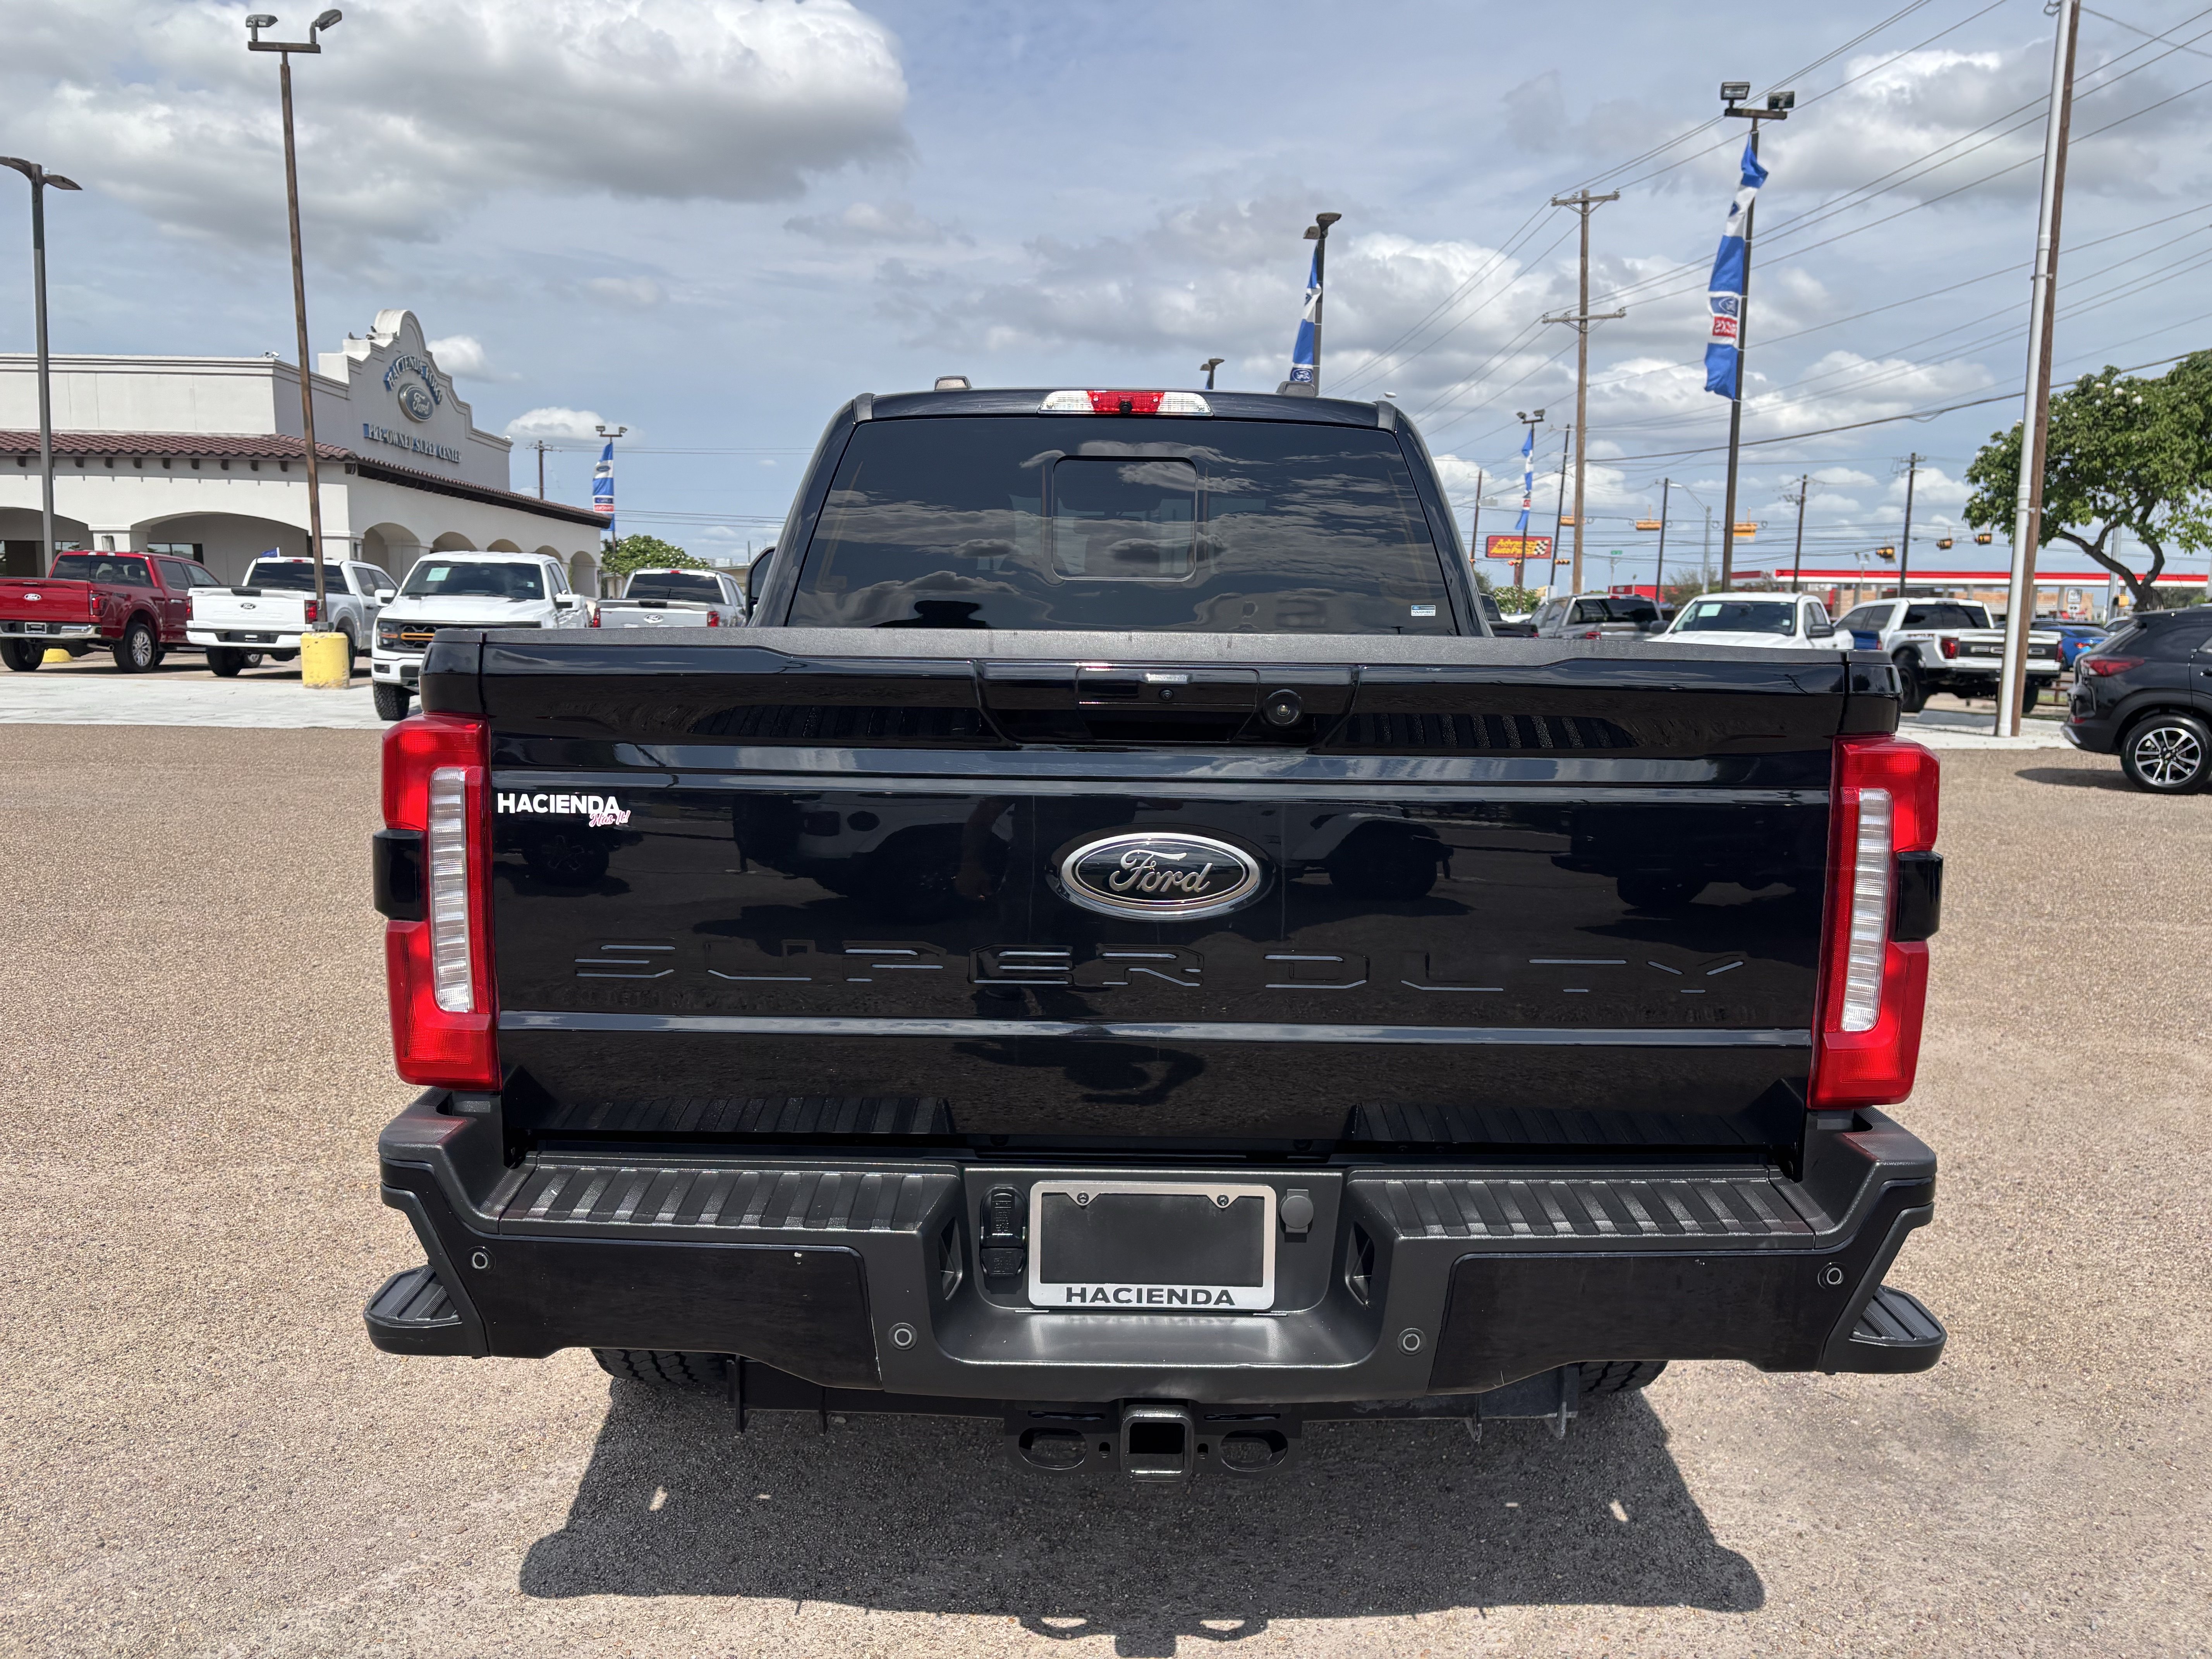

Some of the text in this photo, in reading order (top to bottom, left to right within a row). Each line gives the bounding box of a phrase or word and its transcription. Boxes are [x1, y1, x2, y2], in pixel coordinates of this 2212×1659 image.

[412, 392, 430, 415] Ford
[1511, 545, 1535, 555] Pats
[1970, 646, 2046, 655] FOD
[497, 793, 620, 814] HACIENDA
[1109, 849, 1213, 893] Ford
[575, 937, 1747, 994] SUPER DUTY
[1066, 1287, 1236, 1306] HACIENDA
